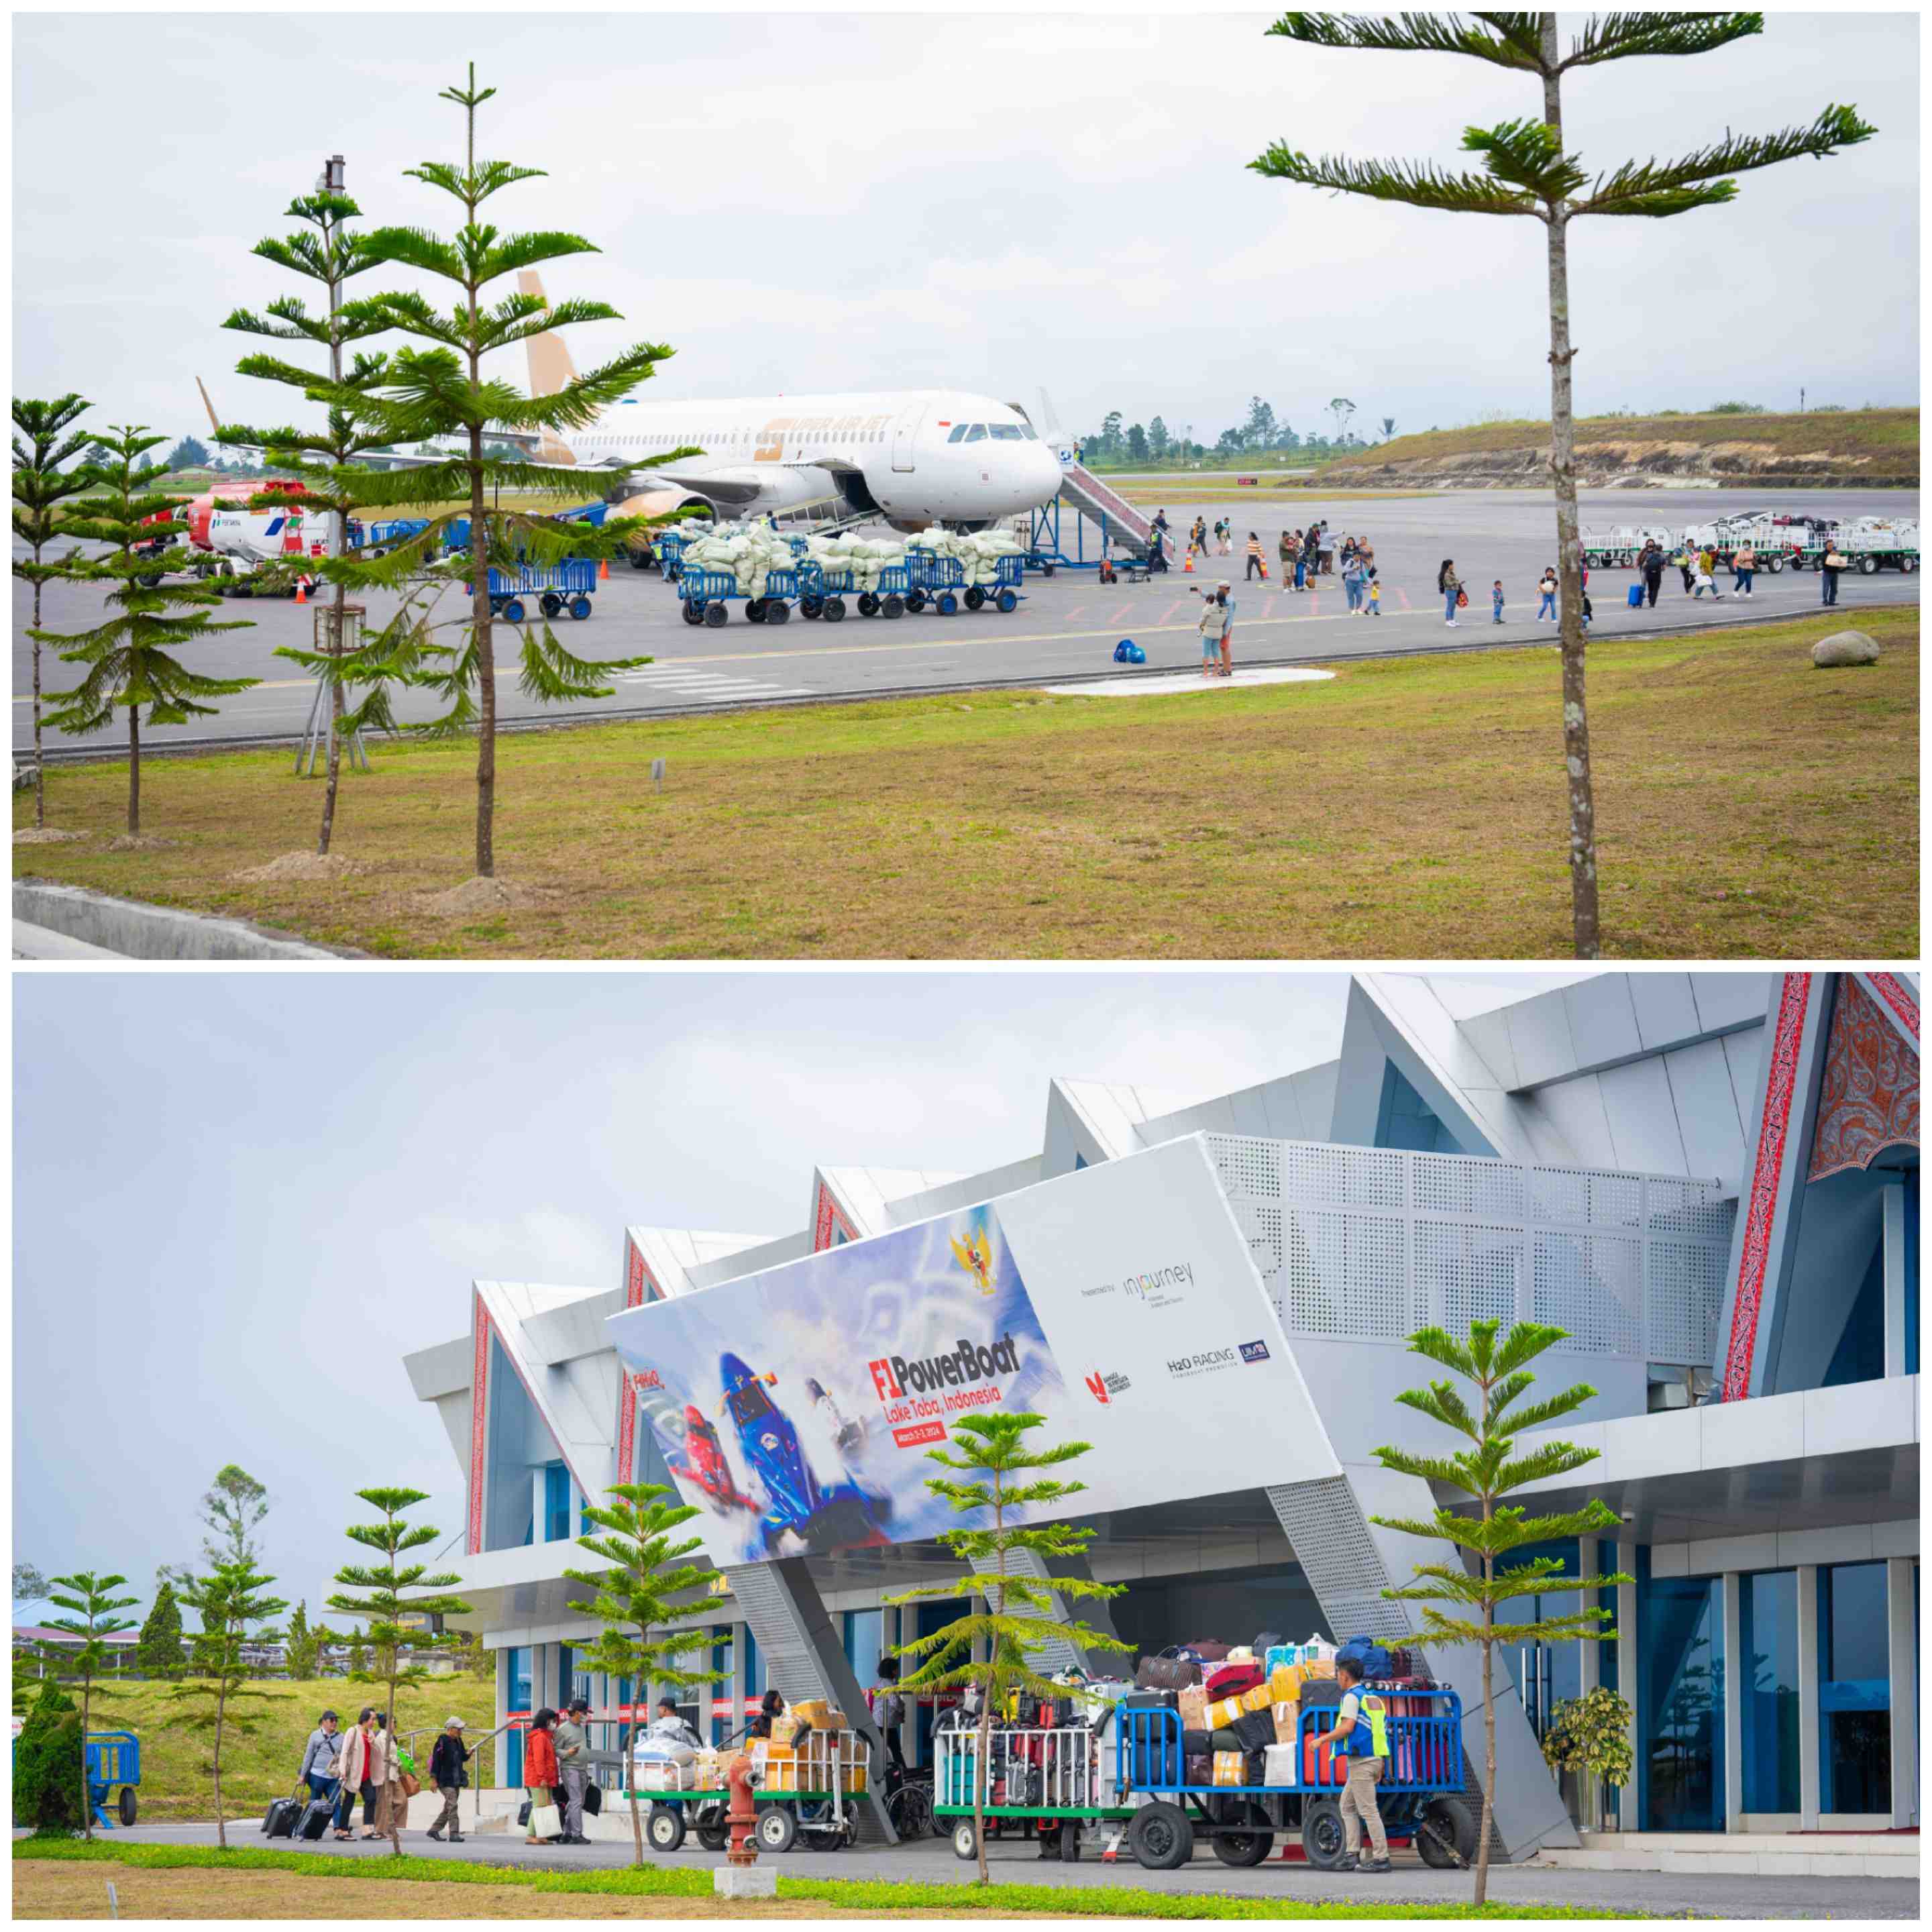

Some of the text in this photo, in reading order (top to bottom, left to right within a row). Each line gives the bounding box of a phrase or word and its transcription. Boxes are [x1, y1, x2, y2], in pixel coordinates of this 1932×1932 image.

[1167, 1348, 1235, 1373] H2O RACING
[883, 1405, 912, 1424] Lake
[942, 1383, 1003, 1412] Indonesia
